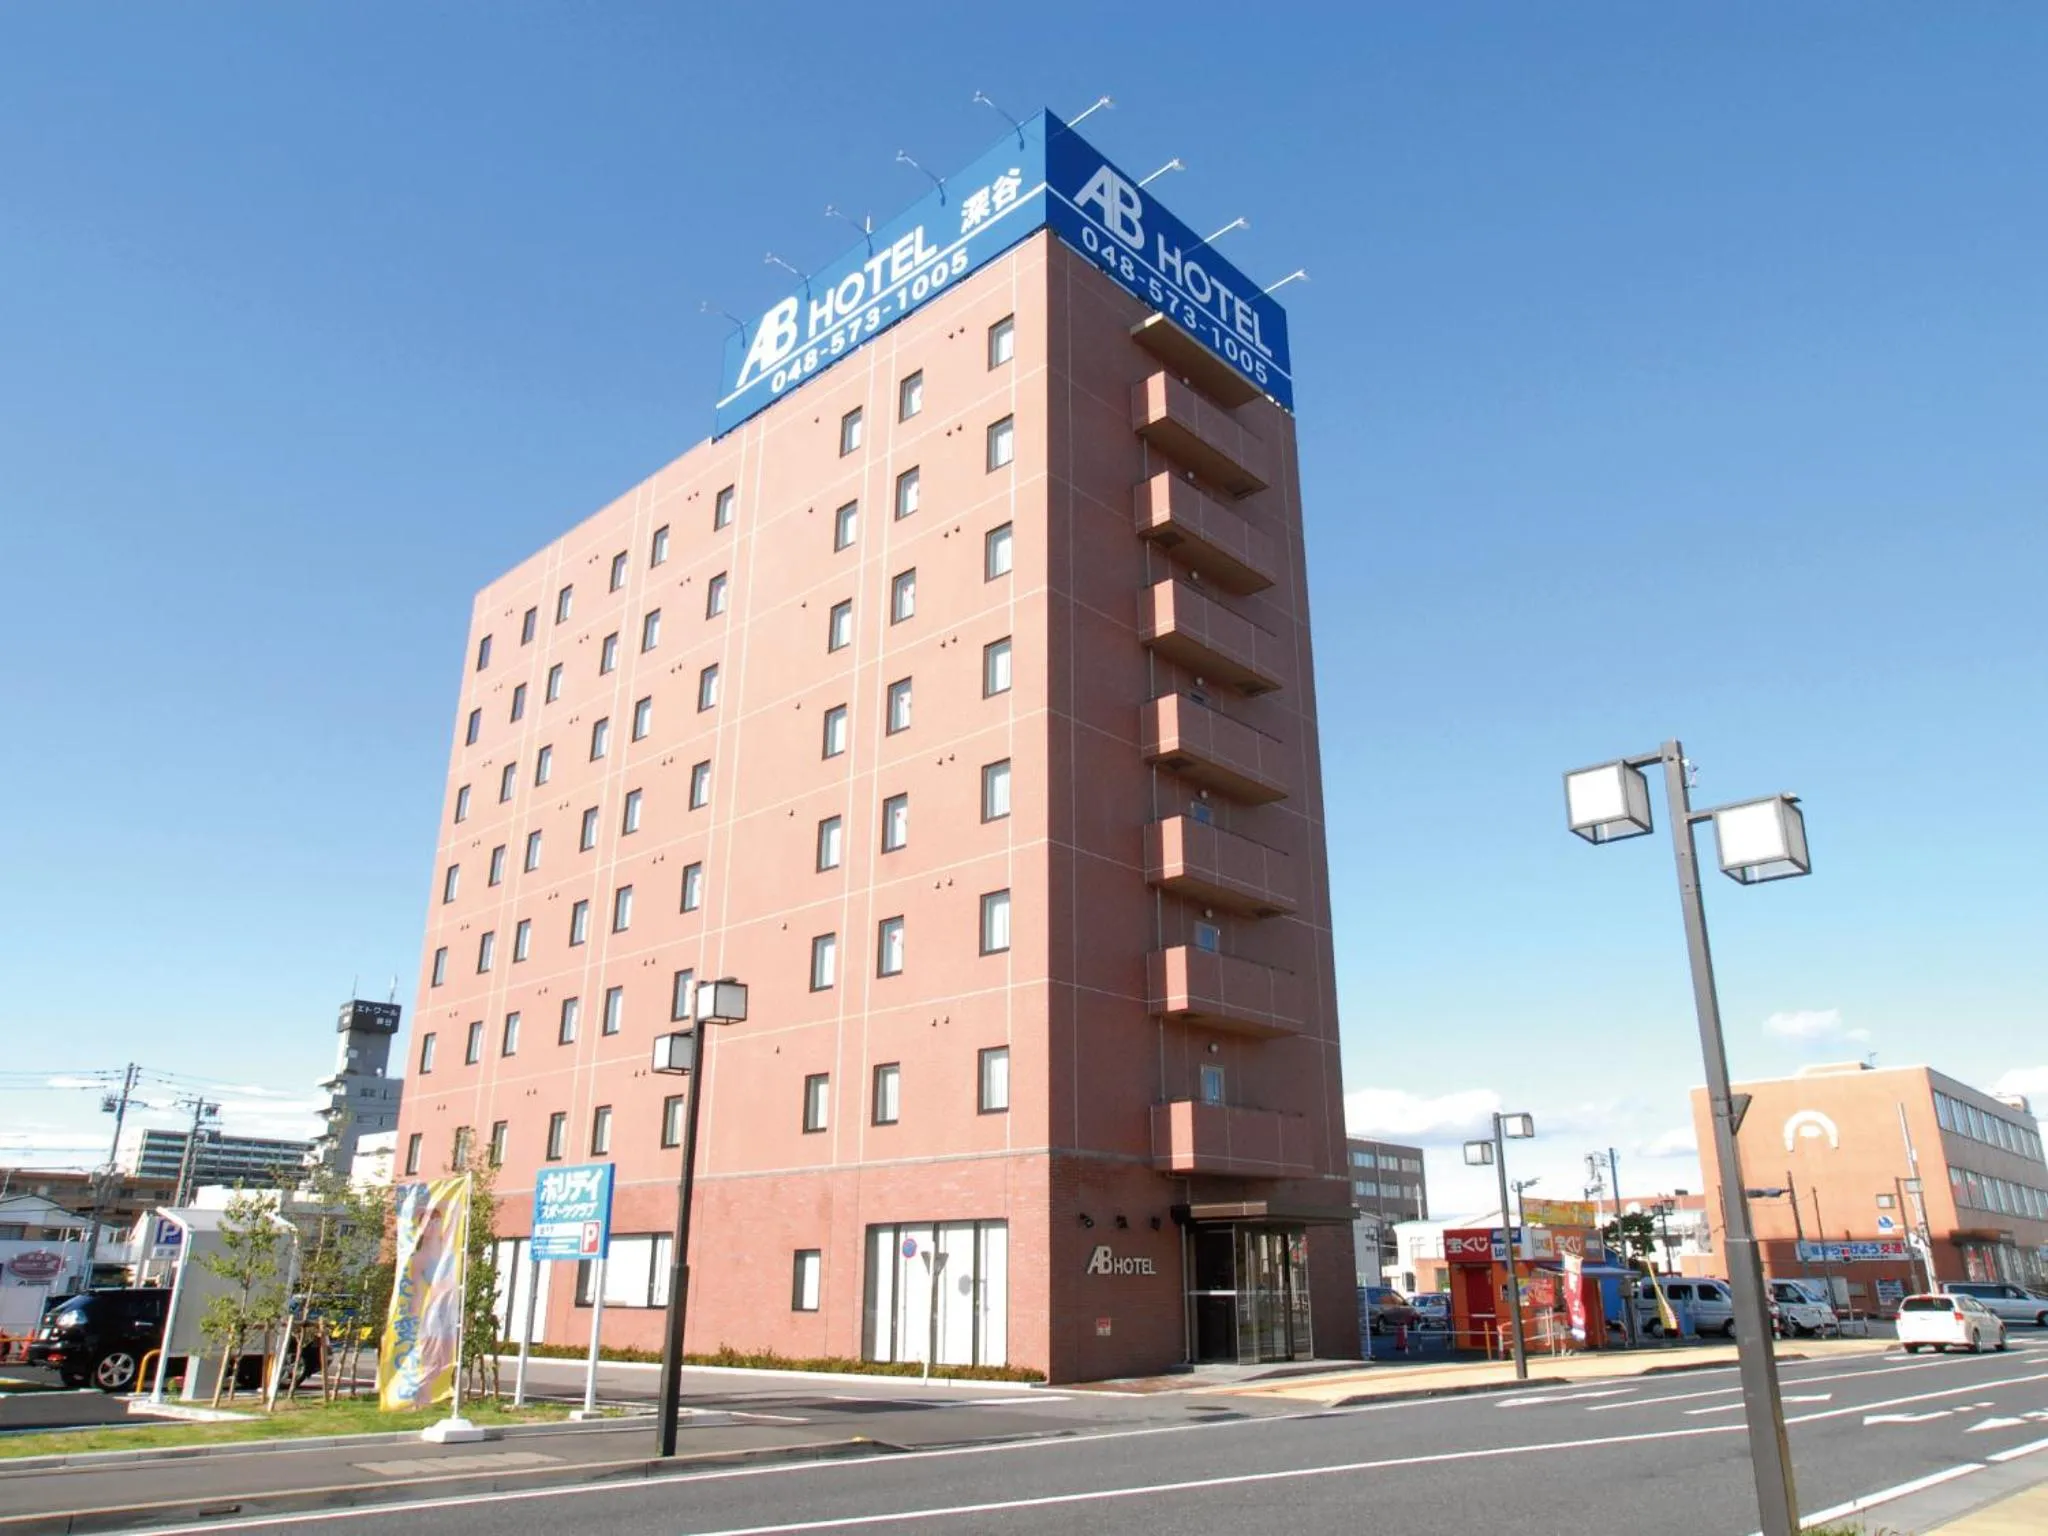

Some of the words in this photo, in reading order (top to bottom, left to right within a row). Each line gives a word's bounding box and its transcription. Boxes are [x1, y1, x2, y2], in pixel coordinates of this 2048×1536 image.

[736, 296, 799, 388] AB
[808, 226, 938, 338] HOTEL
[960, 168, 1022, 234] 深谷
[771, 248, 969, 393] 048-573-1005
[1073, 164, 1145, 250] AB
[1157, 232, 1273, 357] HOTEL
[1081, 226, 1268, 384] 048-573-1005
[583, 1222, 599, 1251] P
[1087, 1246, 1112, 1274] AB
[1113, 1257, 1156, 1275] HOTEL
[1446, 1236, 1488, 1254] 宝くじ
